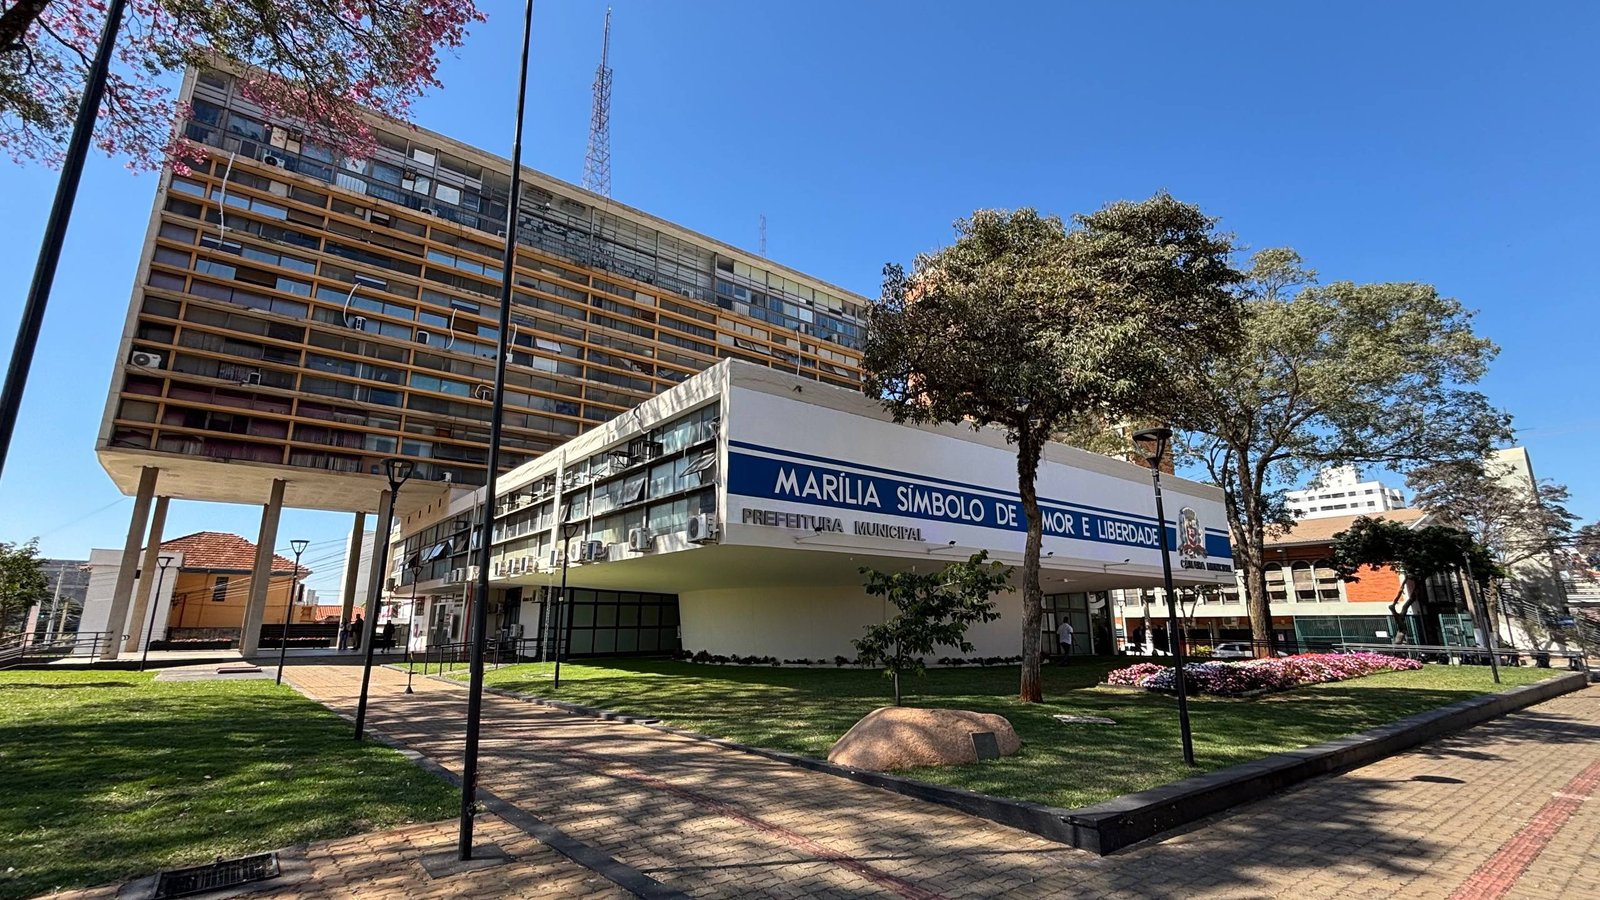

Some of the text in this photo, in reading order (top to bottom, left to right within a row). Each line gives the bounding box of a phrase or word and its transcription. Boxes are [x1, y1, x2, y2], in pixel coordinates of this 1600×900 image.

[742, 508, 926, 542] PREFEITURA MUNICIPAL
[774, 466, 1160, 546] MARÍLIA SÍMBOLO DE MOR E LIBERDADE
